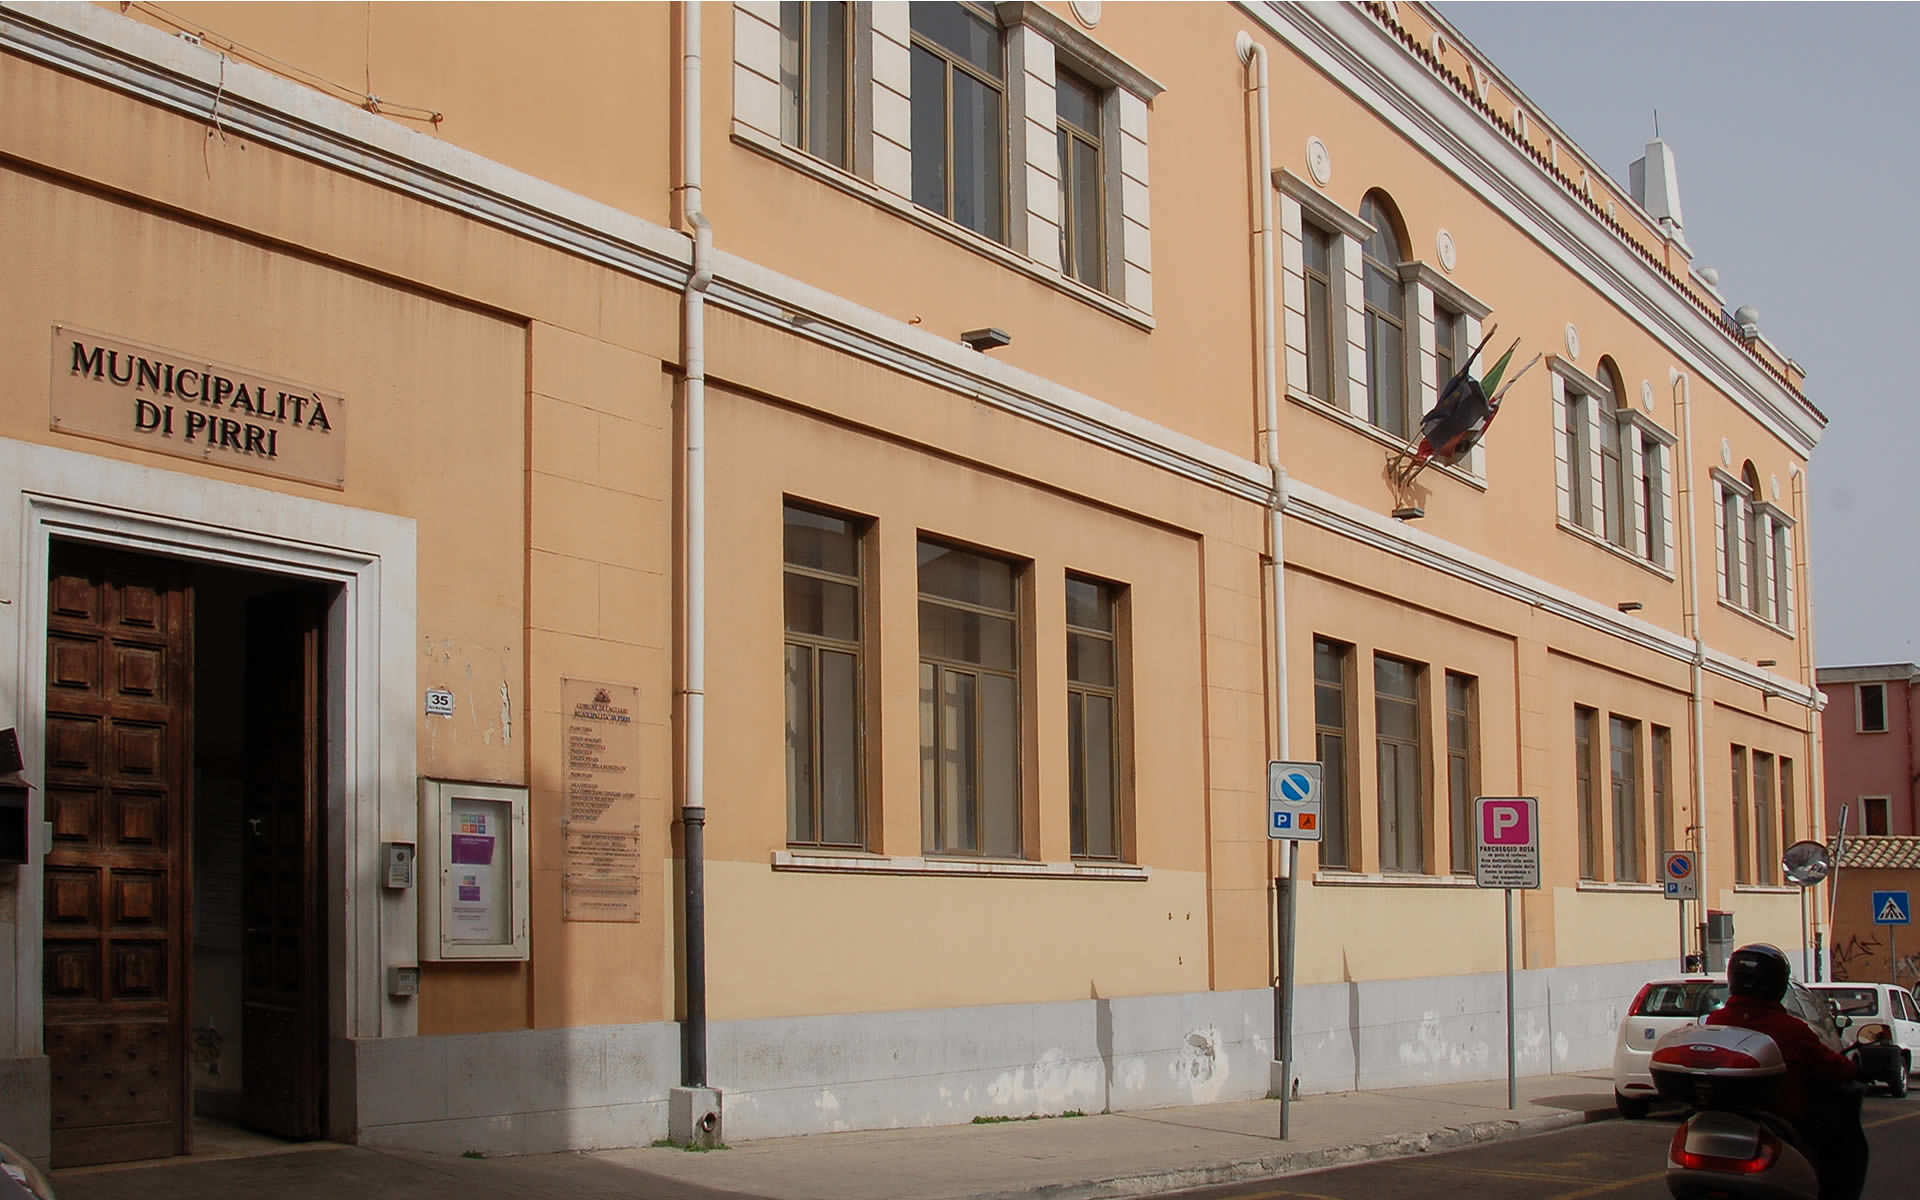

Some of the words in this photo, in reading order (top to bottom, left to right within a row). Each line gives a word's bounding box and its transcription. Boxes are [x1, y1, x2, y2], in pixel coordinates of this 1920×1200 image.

[71, 341, 333, 432] MUNICIPALITÀ
[135, 398, 174, 434] DI
[185, 409, 279, 457] PIRRI
[432, 694, 448, 706] 35
[1278, 814, 1288, 826] P
[1493, 807, 1519, 839] P
[1669, 884, 1676, 892] P
